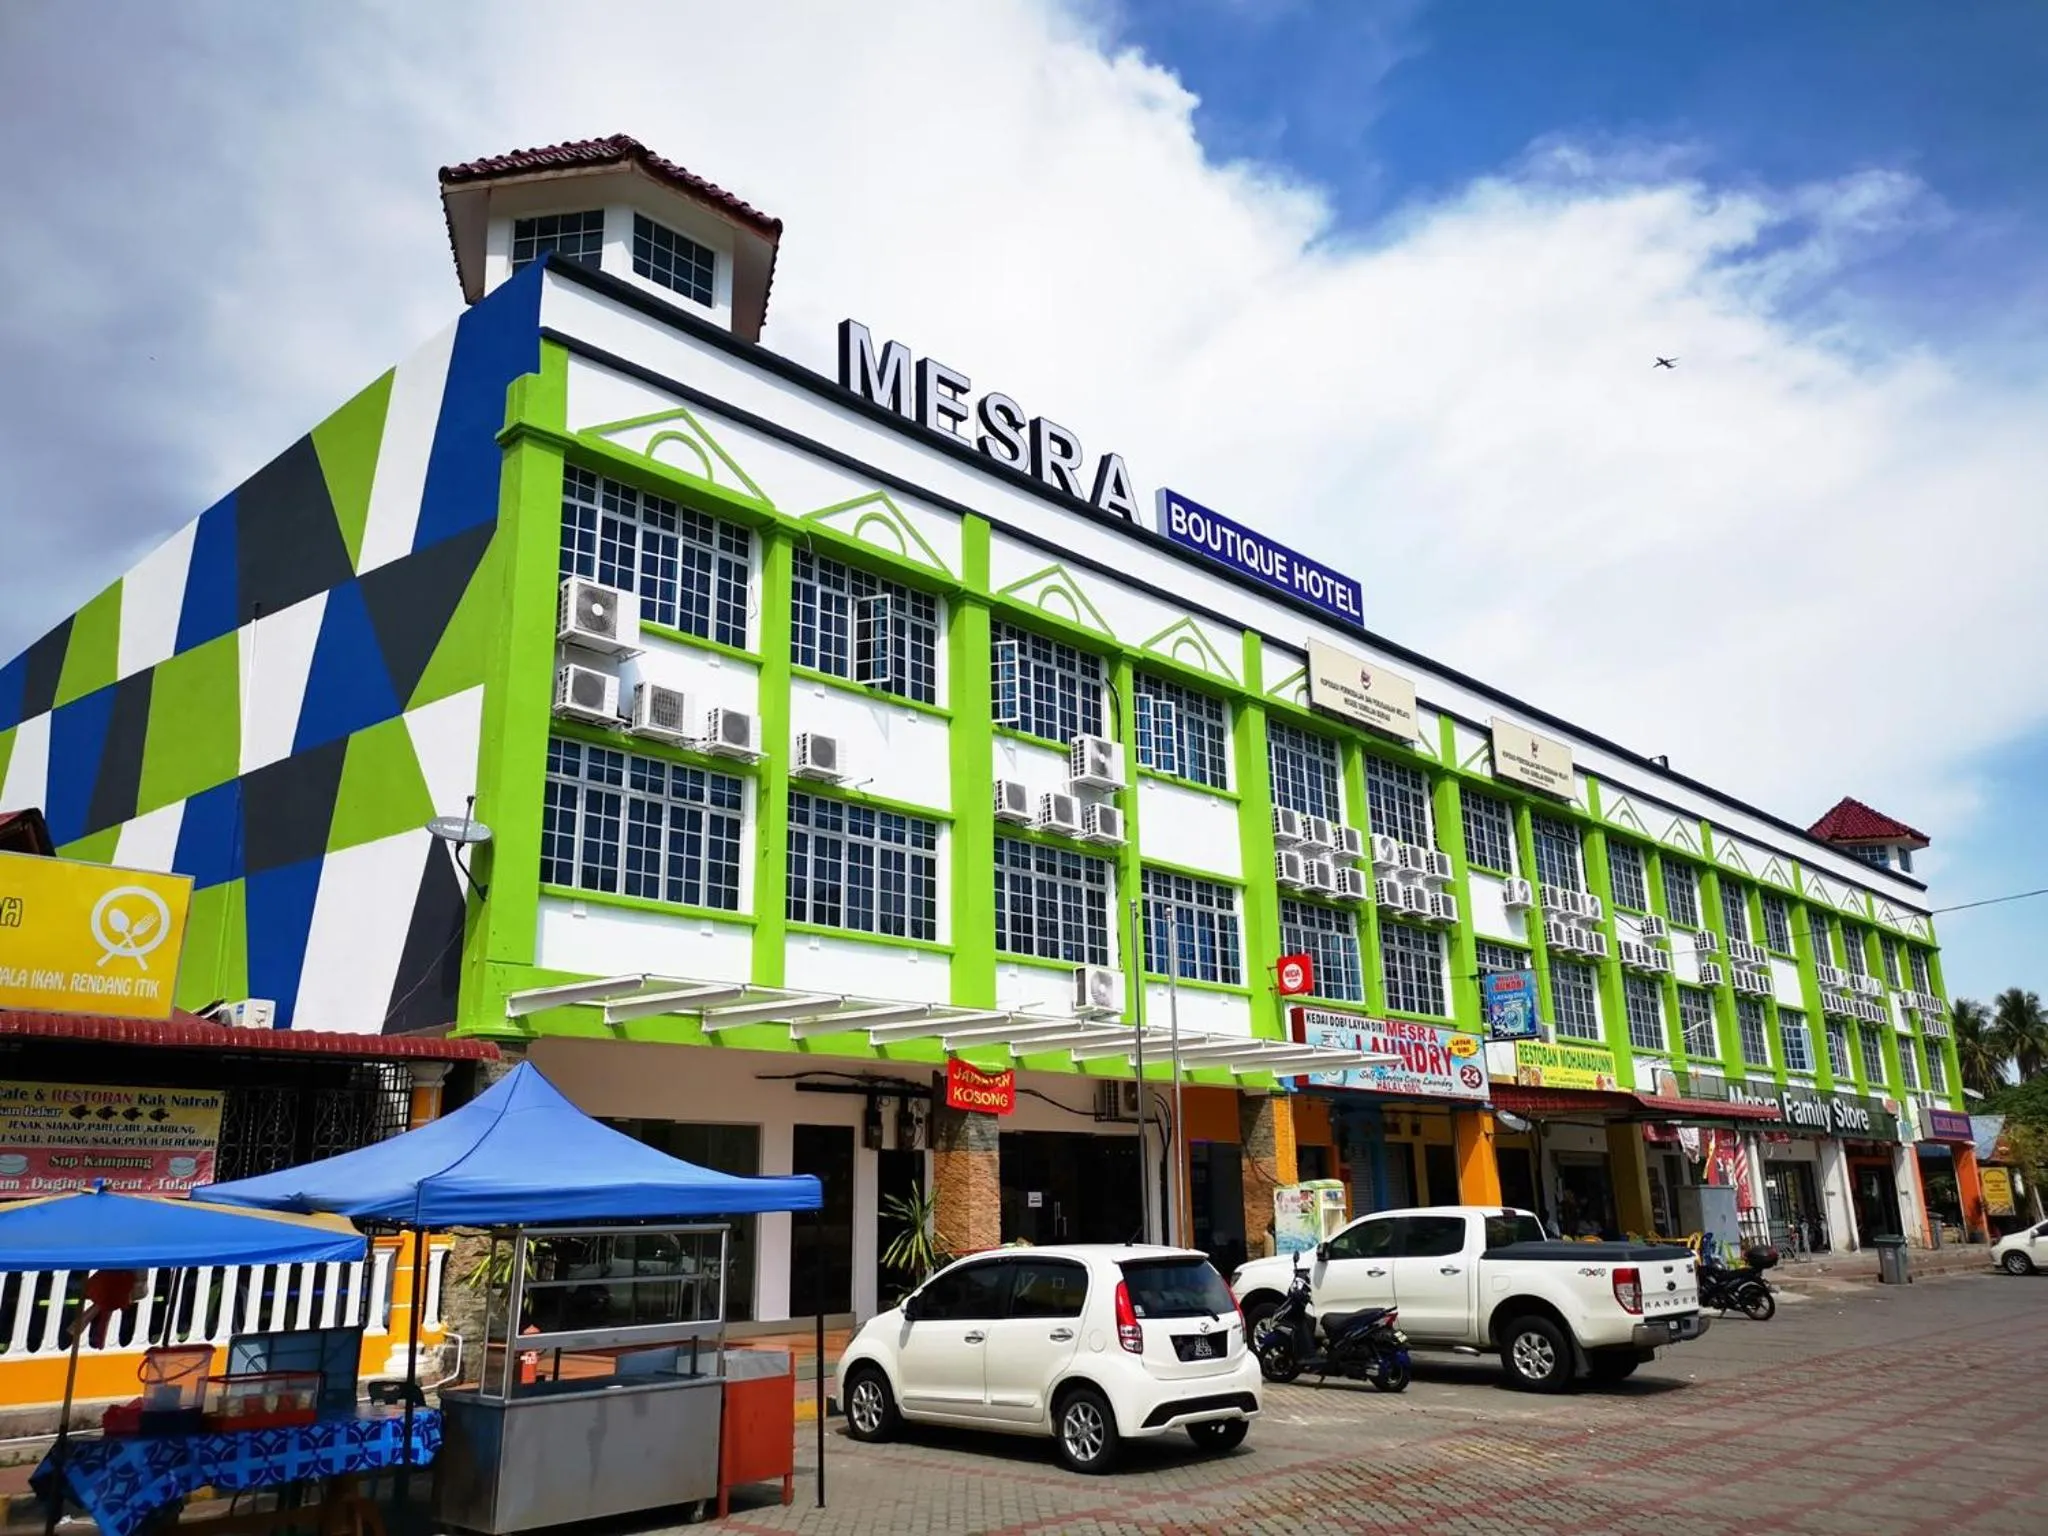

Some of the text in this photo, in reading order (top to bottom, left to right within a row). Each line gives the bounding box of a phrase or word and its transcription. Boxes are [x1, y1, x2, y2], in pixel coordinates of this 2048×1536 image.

[838, 318, 1142, 527] MESRA
[1171, 502, 1360, 617] BOUTIQUE HOTEL
[70, 972, 131, 995] RENDANG
[134, 978, 160, 998] ITIK
[1306, 1012, 1328, 1025] KEDAI
[1348, 1018, 1371, 1032] LAYAN
[1386, 1021, 1438, 1044] MESRA
[1519, 1043, 1558, 1068] RESTORAN
[1422, 1077, 1454, 1092] Laundry
[1462, 1067, 1480, 1084] 24
[34, 1089, 45, 1101] &
[52, 1090, 133, 1105] RESTORAN
[138, 1093, 166, 1106] Kak
[171, 1095, 219, 1108] Natrah
[952, 1086, 1008, 1108] KOSONG
[1782, 1091, 1832, 1133] Family
[1833, 1097, 1870, 1130] Store
[51, 1155, 153, 1170] Sup Kampung
[1645, 1296, 1697, 1309] RANGER
